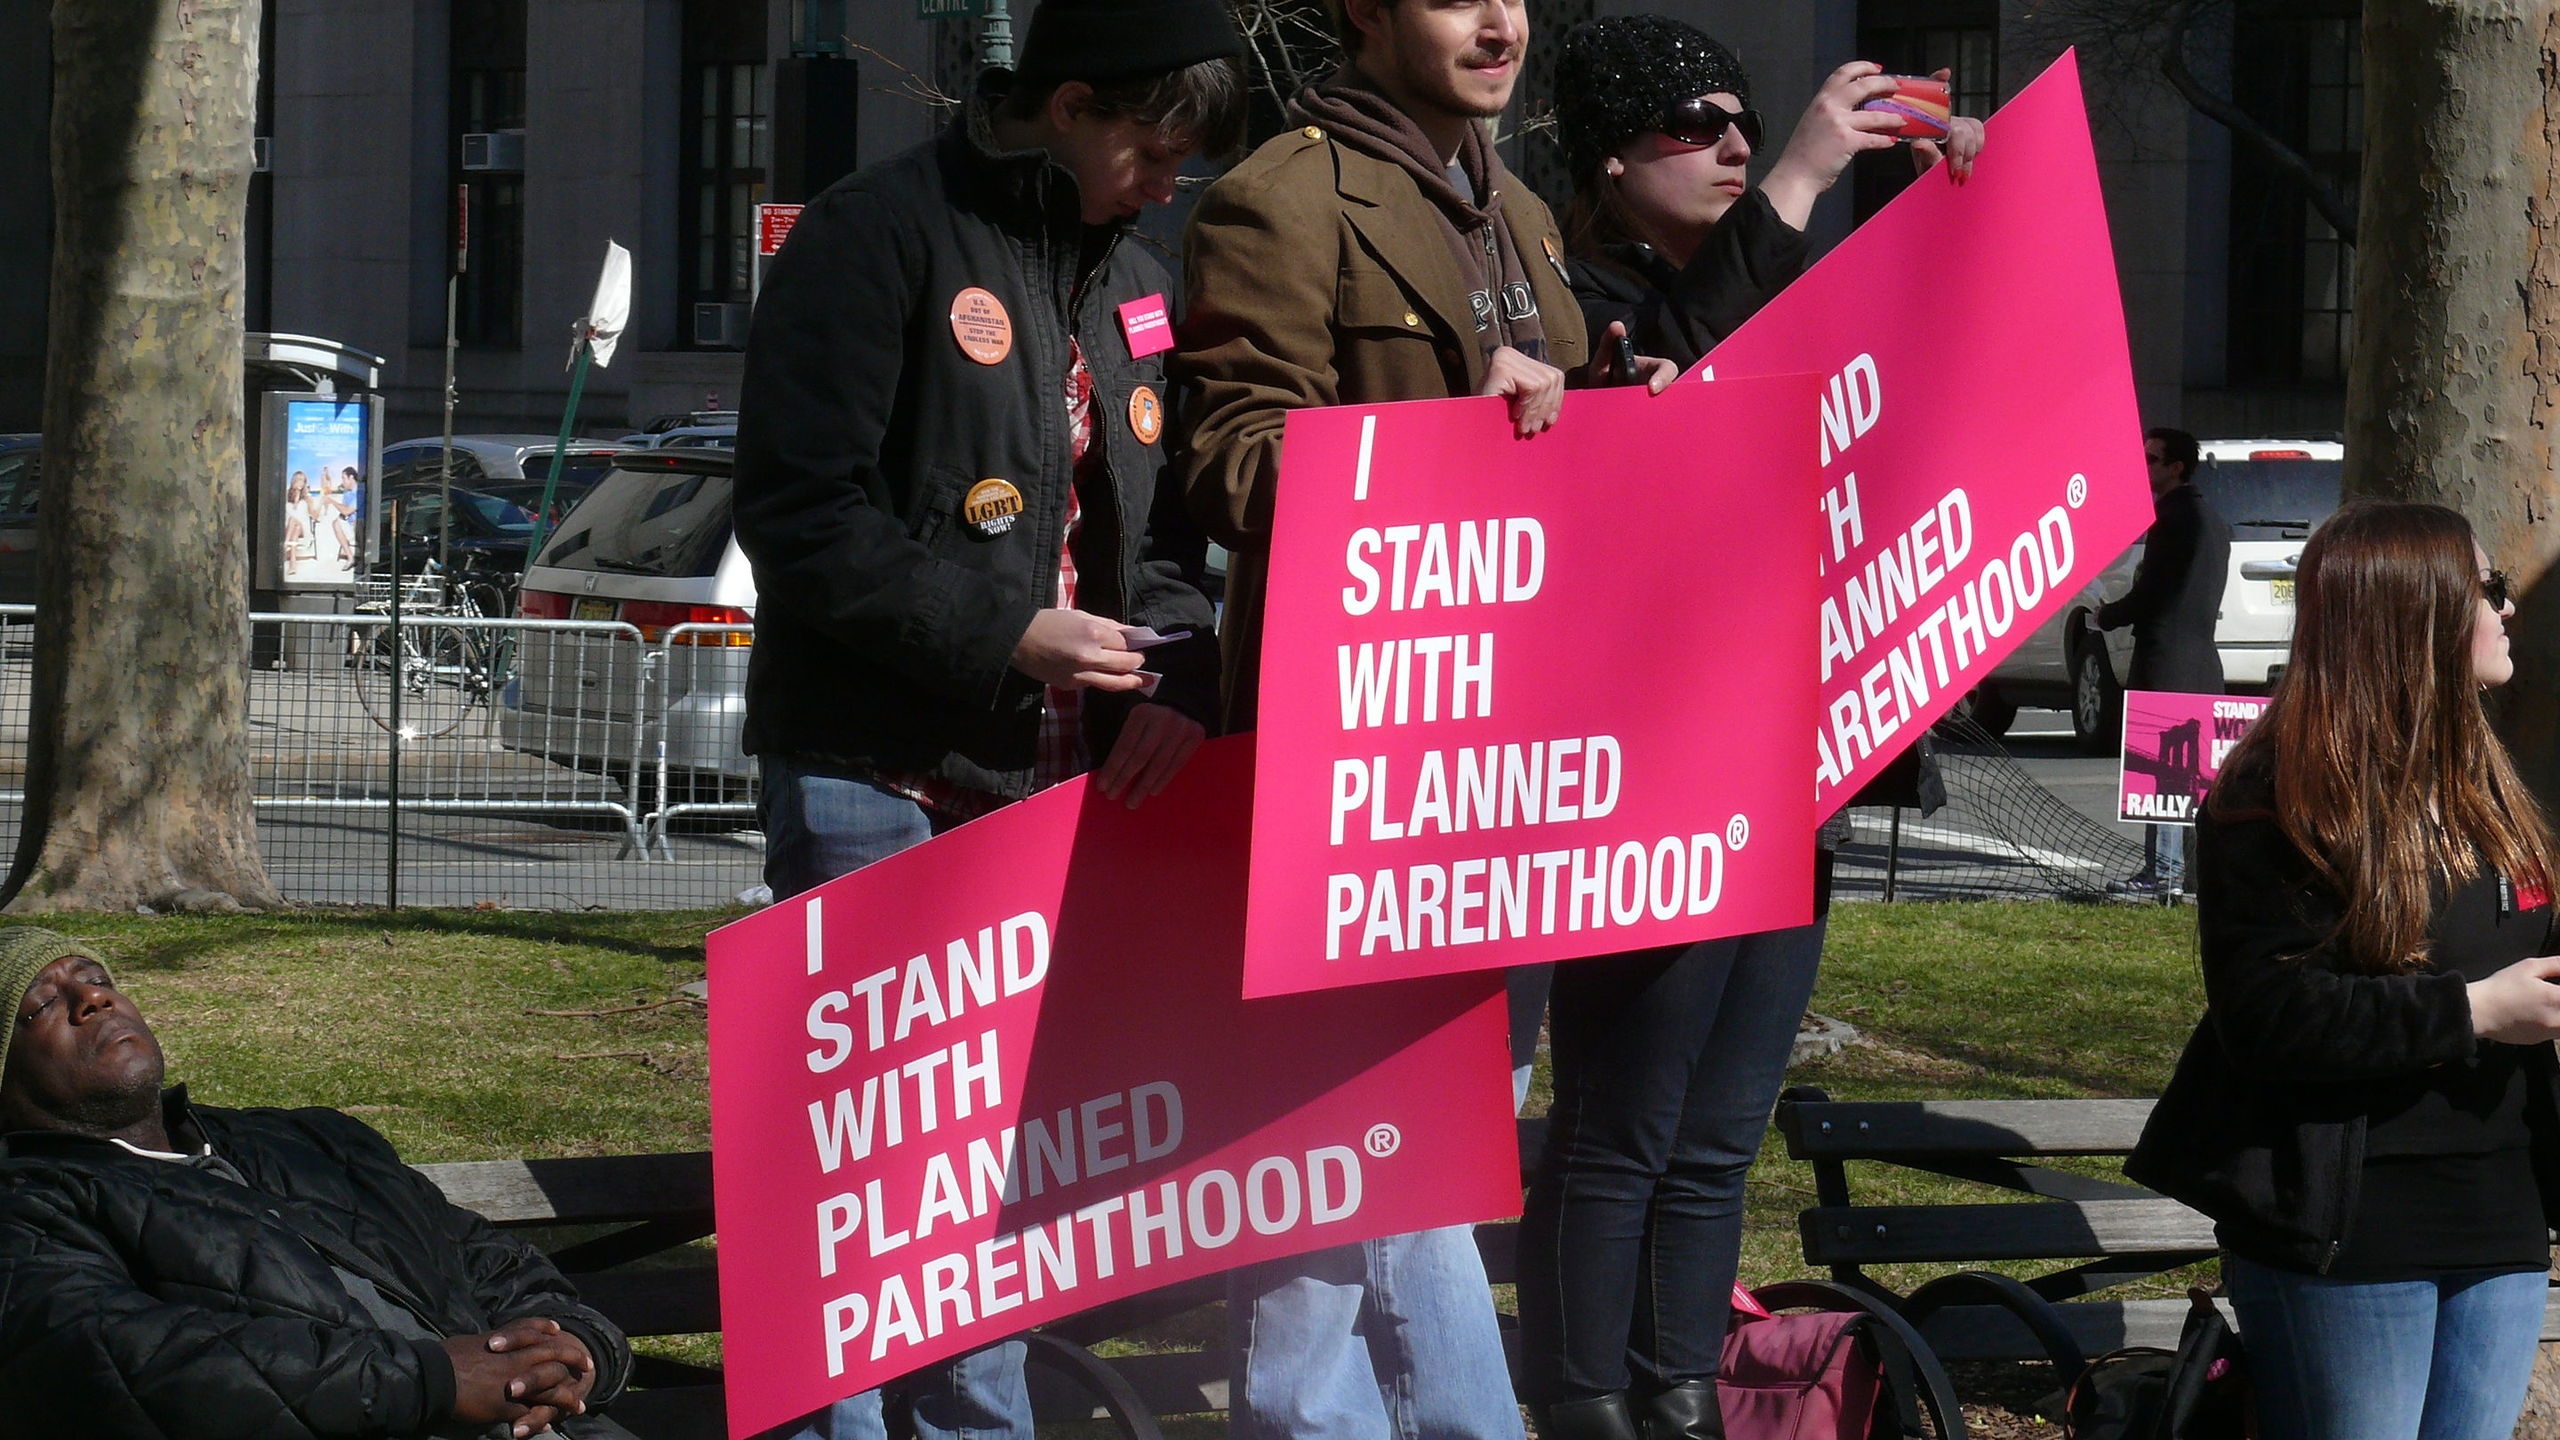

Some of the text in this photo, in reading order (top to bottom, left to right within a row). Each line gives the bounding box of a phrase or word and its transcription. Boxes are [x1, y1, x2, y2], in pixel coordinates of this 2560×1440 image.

[958, 313, 1005, 326] AFGHANISTAN
[969, 327, 984, 335] STOP
[294, 422, 315, 433] Just
[1355, 415, 1376, 501] I
[980, 514, 1016, 530] RIGHTS
[987, 523, 1011, 535] NOW!
[1342, 517, 1546, 616] STAND
[1821, 488, 1973, 684] ANNED
[1337, 632, 1494, 730] WITH
[2213, 701, 2259, 719] STAND
[1329, 735, 1622, 846] PLANNED
[2127, 793, 2191, 818] RALLY
[807, 896, 822, 975] I
[806, 911, 1051, 1074] STAND
[807, 1029, 1002, 1174] WITH
[817, 1080, 1185, 1278] PLANNED
